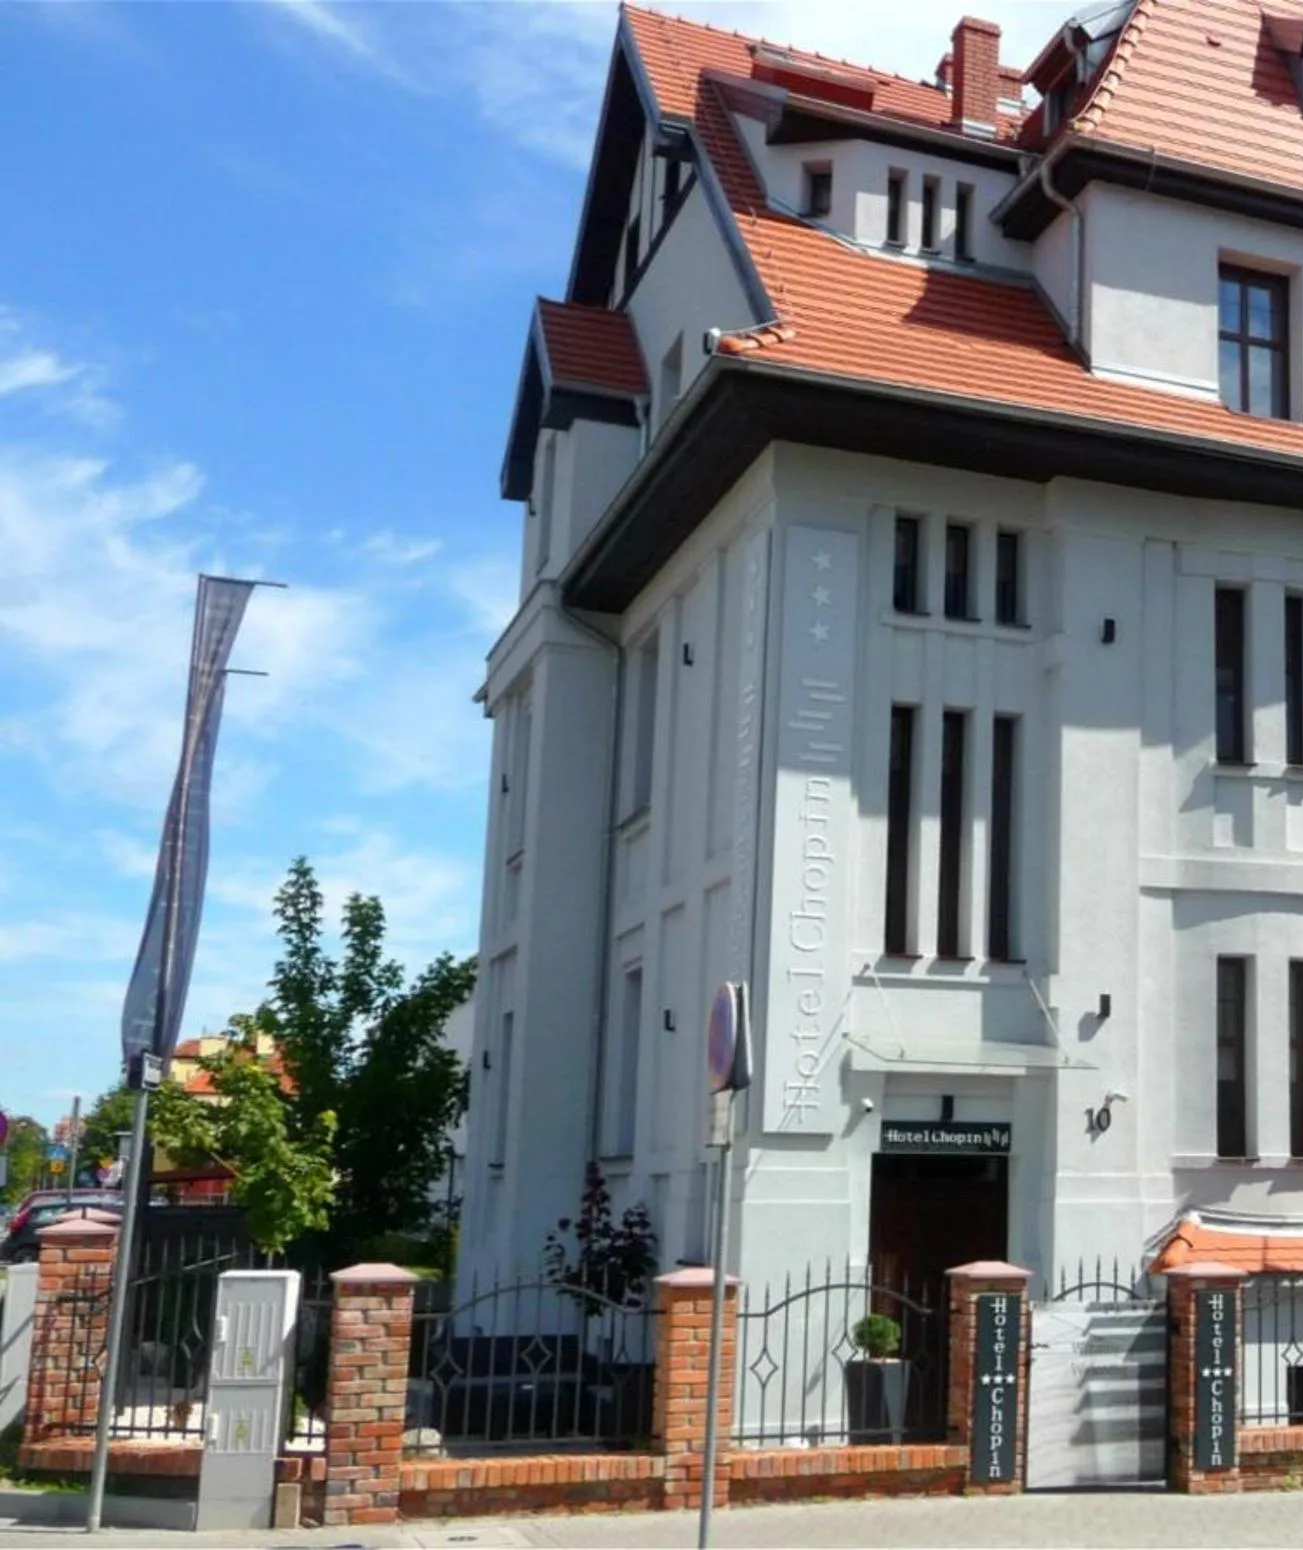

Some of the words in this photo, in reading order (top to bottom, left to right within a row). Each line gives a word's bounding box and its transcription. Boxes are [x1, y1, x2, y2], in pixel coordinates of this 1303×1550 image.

[786, 776, 836, 952] Chopin
[781, 964, 823, 1126] Hotel
[885, 1129, 929, 1143] Hotel
[931, 1129, 982, 1146] Chopin
[1084, 1107, 1111, 1132] 10
[989, 1297, 1008, 1372] Hotel
[1208, 1294, 1224, 1365] Hotel
[988, 1387, 1005, 1478] Chopin
[1210, 1380, 1223, 1466] Chopin
